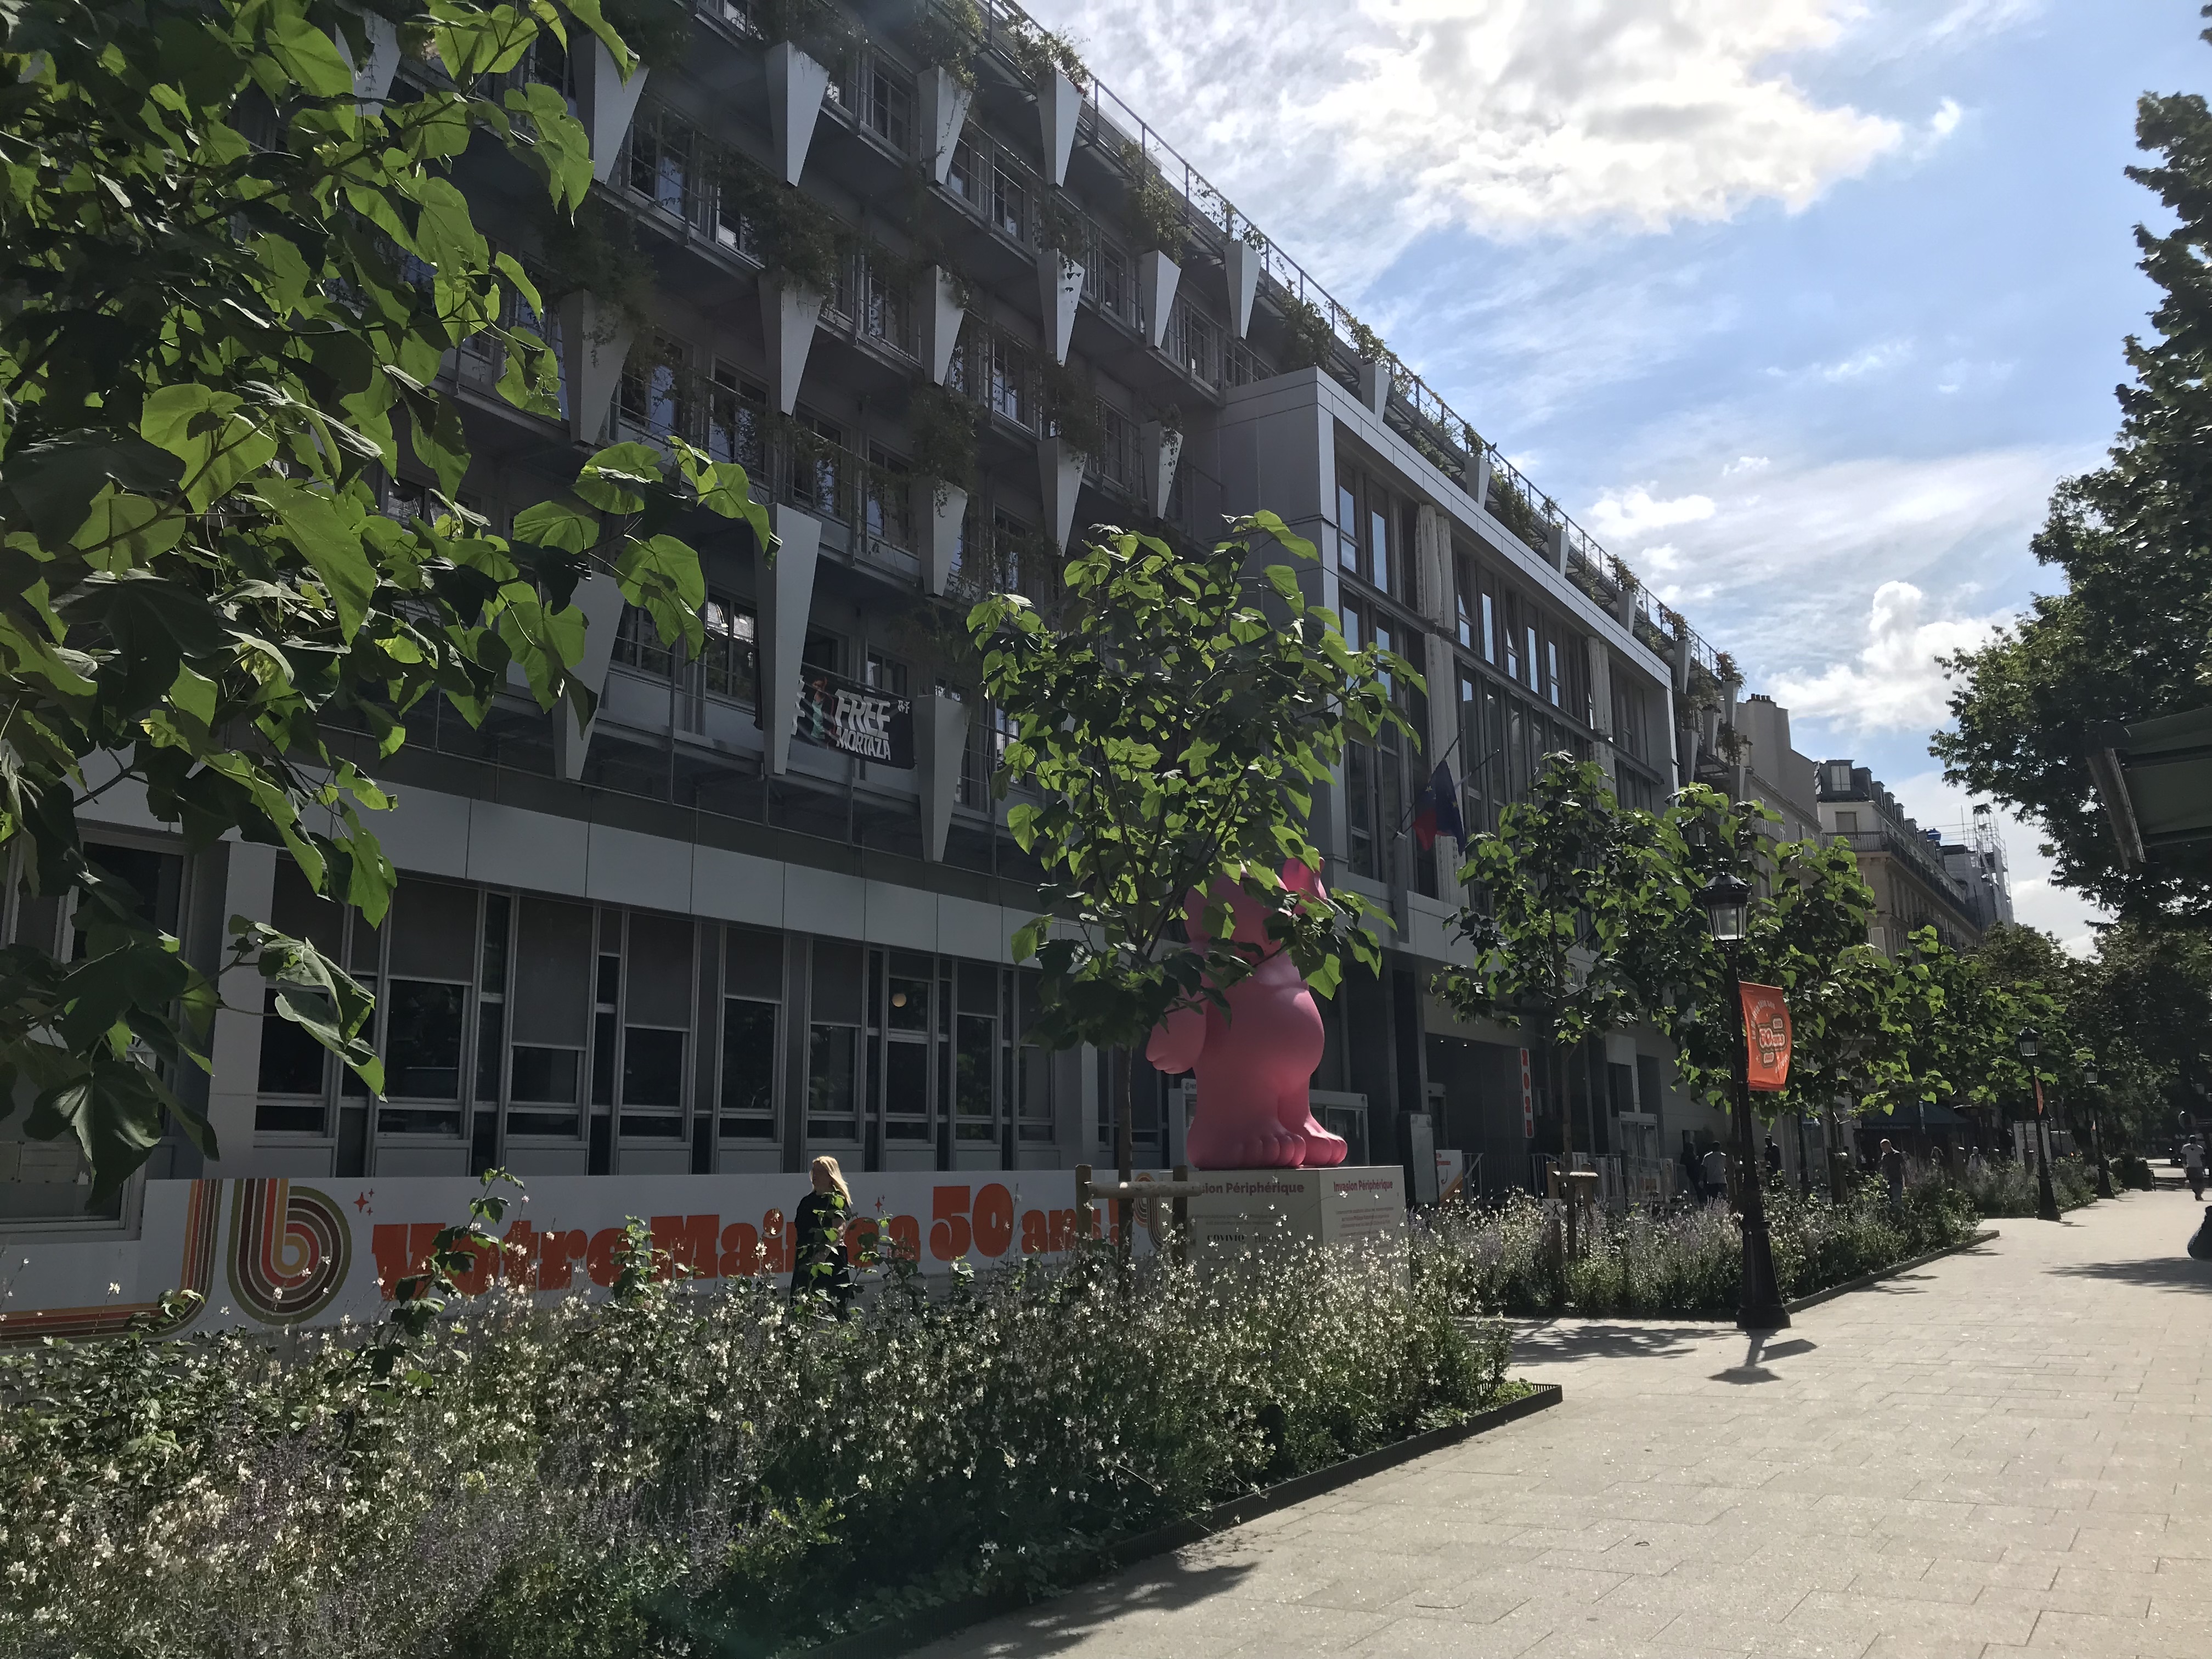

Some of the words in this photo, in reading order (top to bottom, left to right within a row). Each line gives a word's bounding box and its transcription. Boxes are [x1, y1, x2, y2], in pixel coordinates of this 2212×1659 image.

[834, 689, 890, 741] FREE
[836, 726, 891, 761] MORTAZA
[1226, 1182, 1305, 1195] Périphérique
[1334, 1181, 1358, 1192] Invasion
[1358, 1179, 1393, 1193] Périphérique
[371, 1220, 632, 1301] Votre
[930, 1183, 1014, 1261] 50
